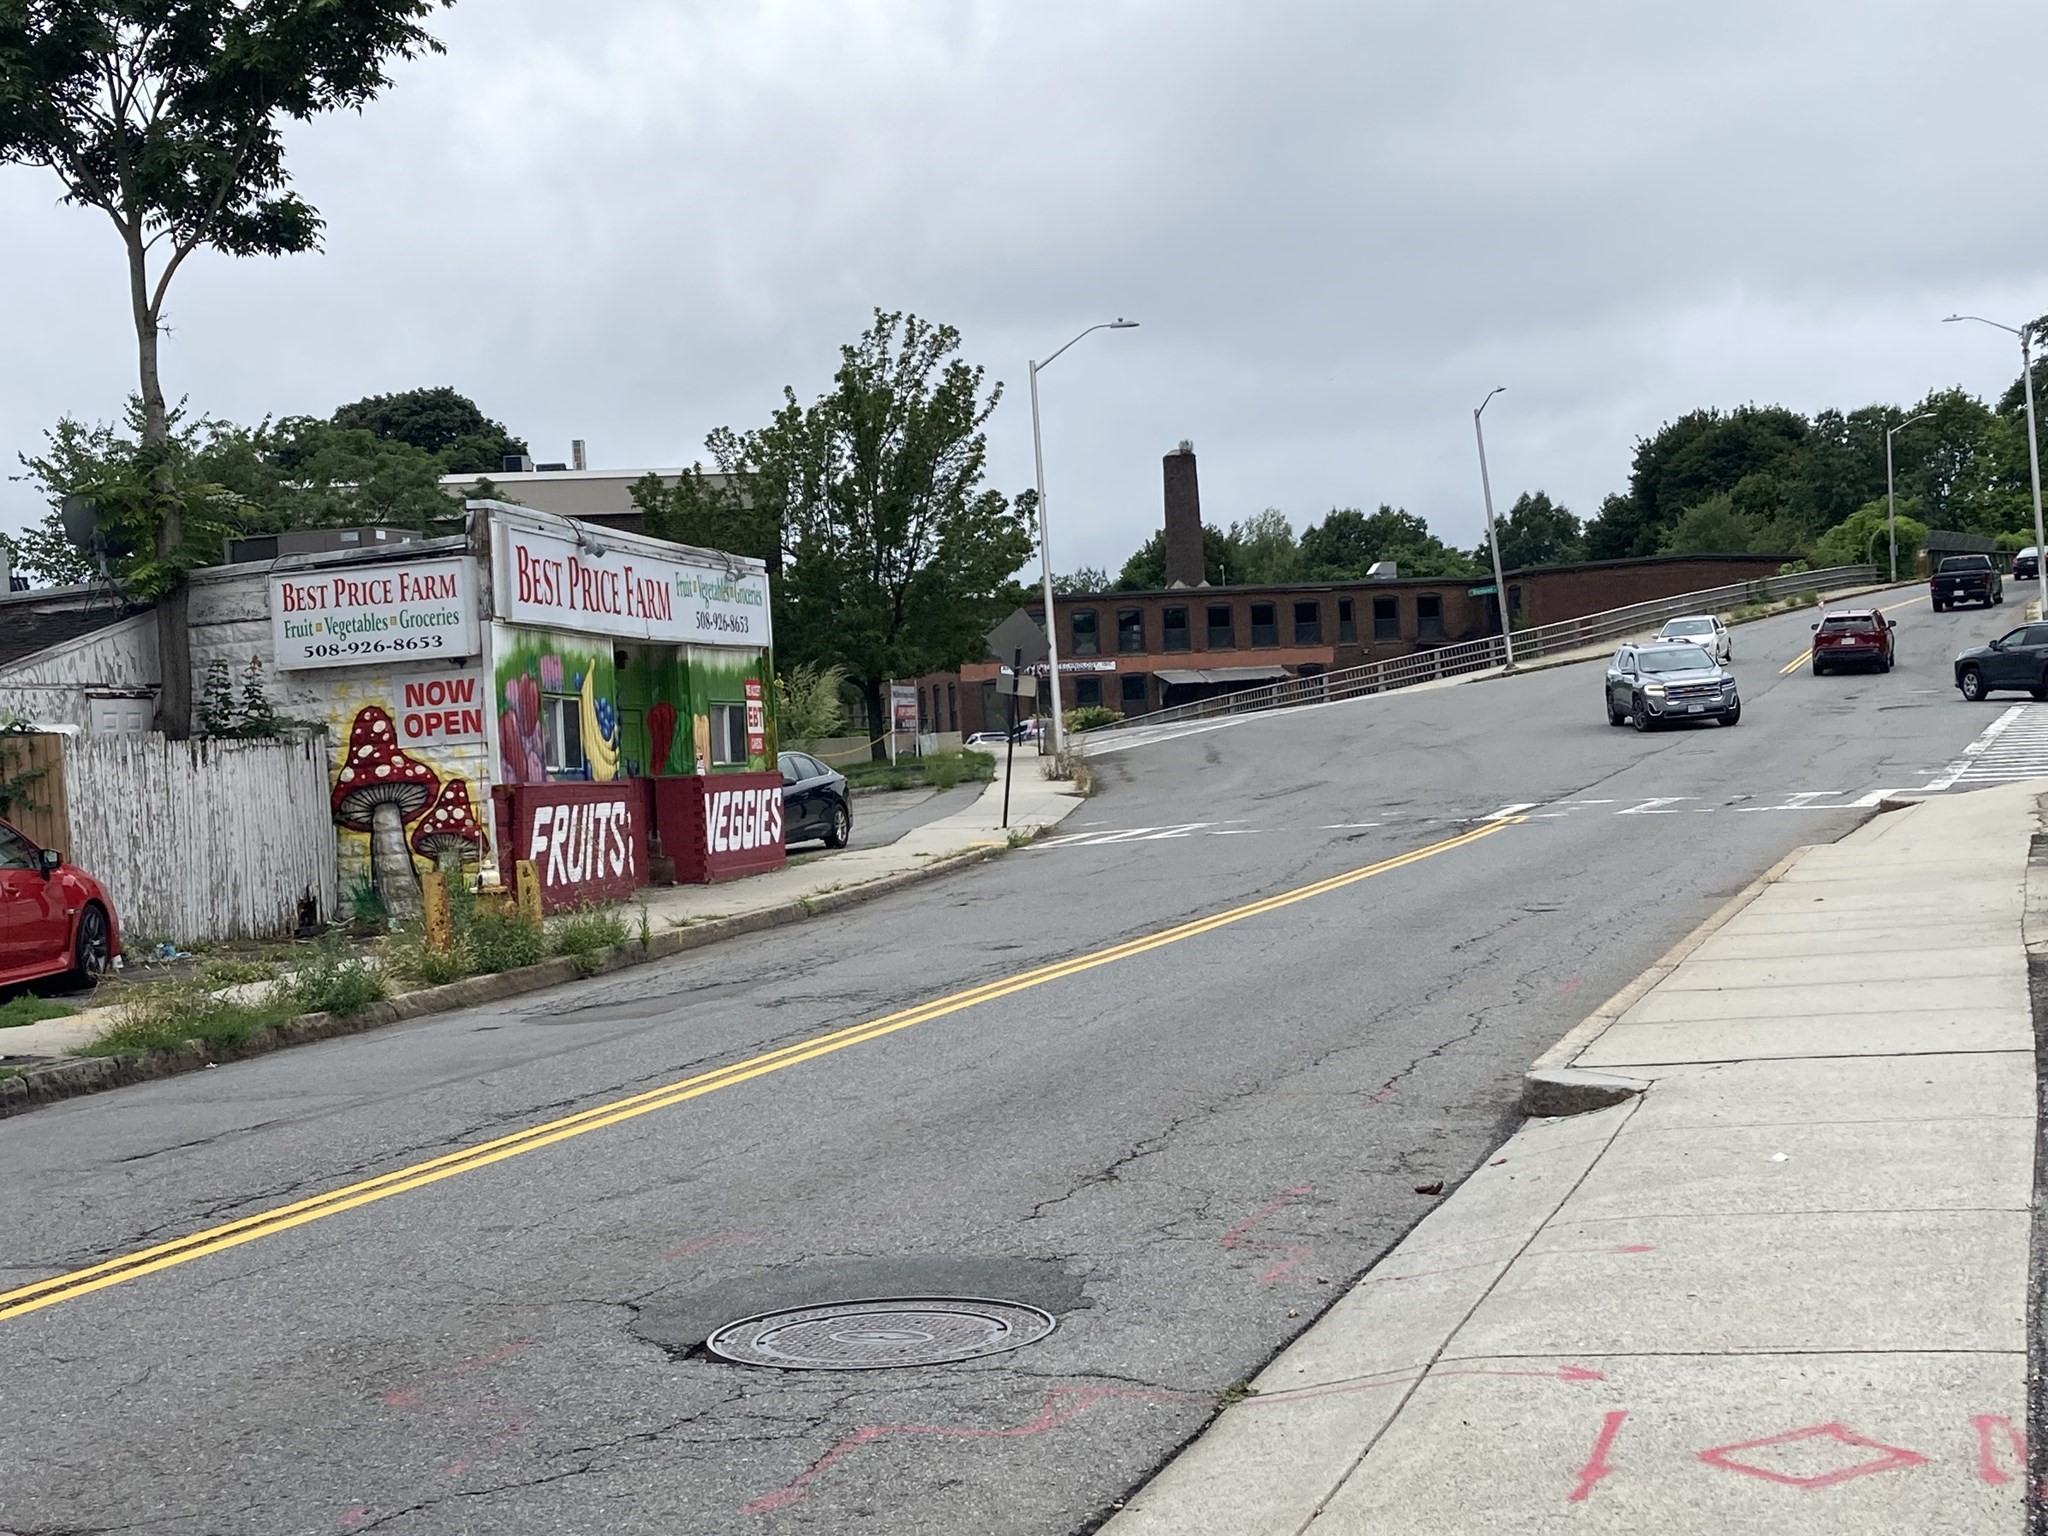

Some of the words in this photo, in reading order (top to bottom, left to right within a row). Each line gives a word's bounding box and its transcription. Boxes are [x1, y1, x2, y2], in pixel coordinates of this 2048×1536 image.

[281, 582, 328, 613] BEST
[333, 578, 394, 608] PRICE
[398, 572, 458, 602] FARM
[515, 545, 563, 607] BEST
[567, 555, 622, 615] PRICE
[623, 565, 673, 621] FARM
[284, 618, 314, 639] Fruit
[324, 612, 389, 642] Vegetables
[399, 607, 460, 629] Groceries
[696, 611, 749, 633] 508-926-8653
[303, 635, 444, 658] 508-926-8653
[405, 678, 475, 708] NOW
[404, 709, 483, 739] OPEN
[749, 706, 763, 728] EBT
[704, 787, 782, 855] VEGGIES
[529, 801, 626, 887] FRUITS
